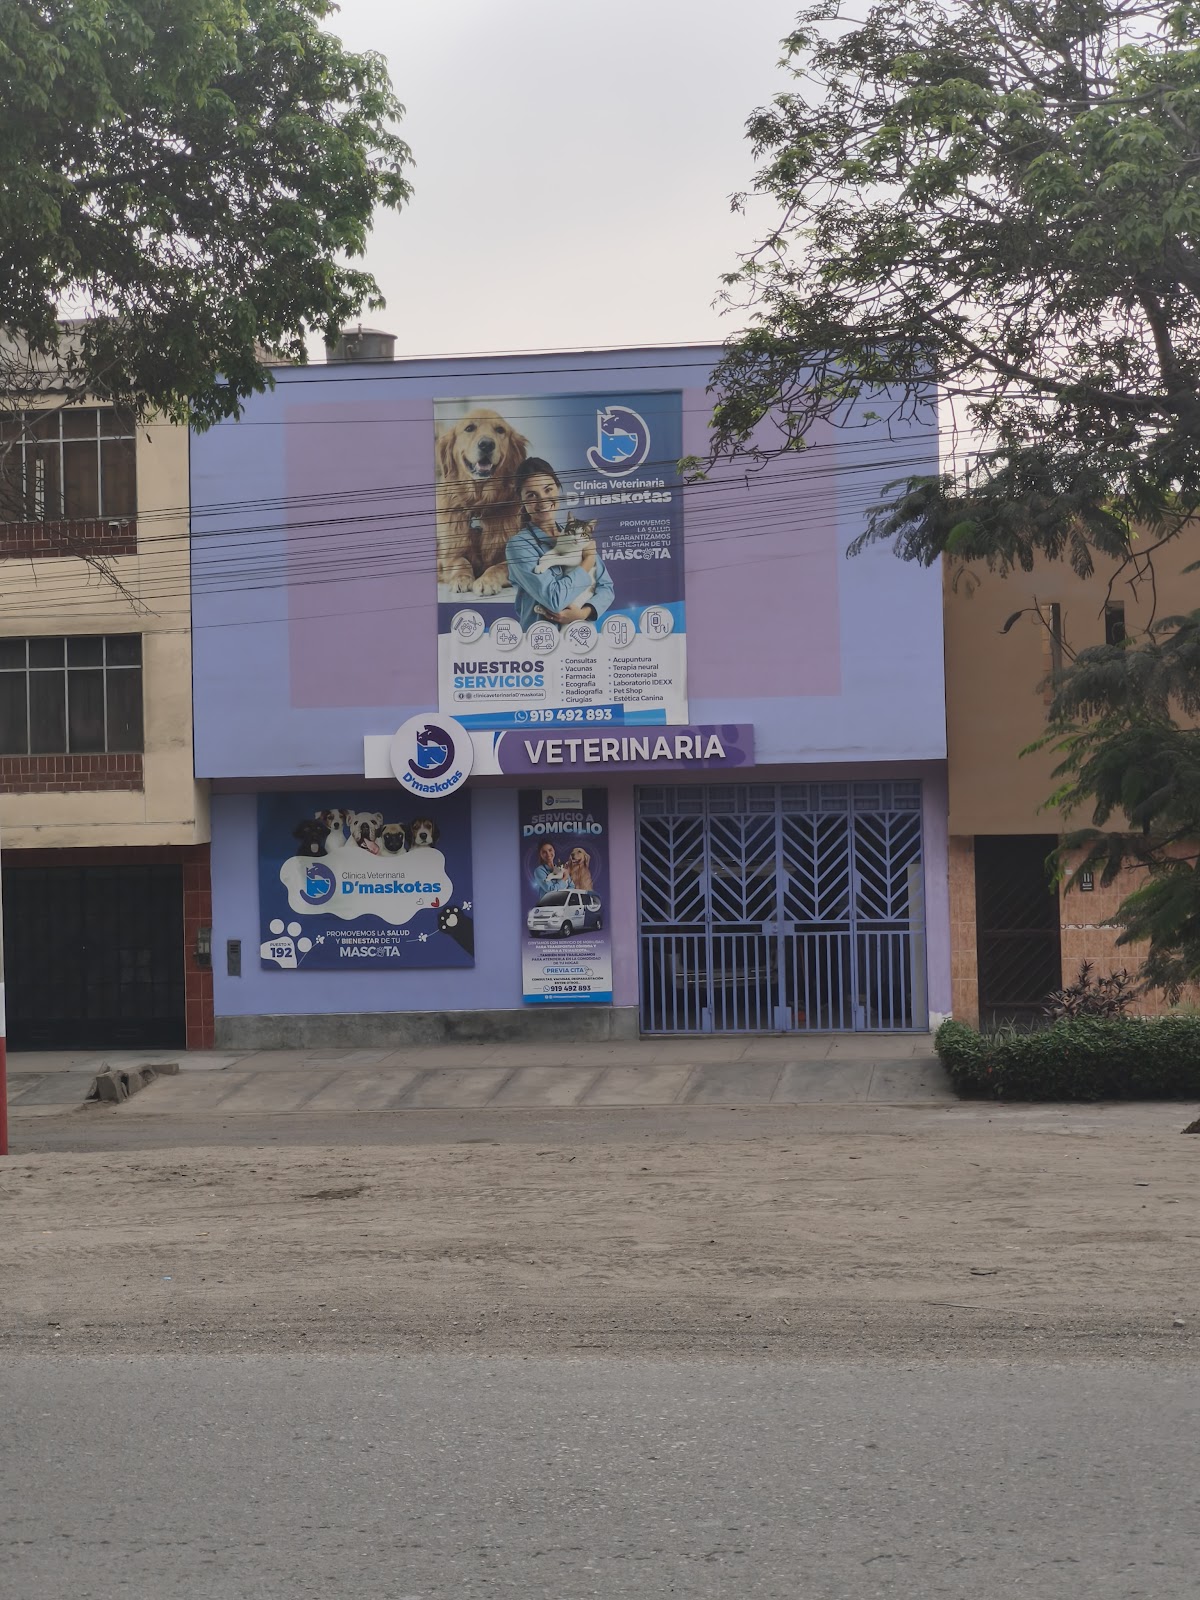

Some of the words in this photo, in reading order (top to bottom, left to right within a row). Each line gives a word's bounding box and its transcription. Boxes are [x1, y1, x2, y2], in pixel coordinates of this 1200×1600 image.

[574, 480, 607, 490] Clínica
[609, 478, 664, 488] Veterinaria
[454, 661, 544, 674] NUESTROS
[454, 675, 544, 688] SERVICIOS
[530, 710, 554, 721] 919
[556, 710, 583, 721] 492
[586, 709, 612, 721] 893
[524, 734, 726, 764] VETERINARIA
[403, 770, 463, 793] D'maskotas
[532, 813, 583, 824] SERVICIO
[586, 814, 594, 822] A
[524, 822, 603, 836] DOMICILIO
[270, 948, 292, 958] 192
